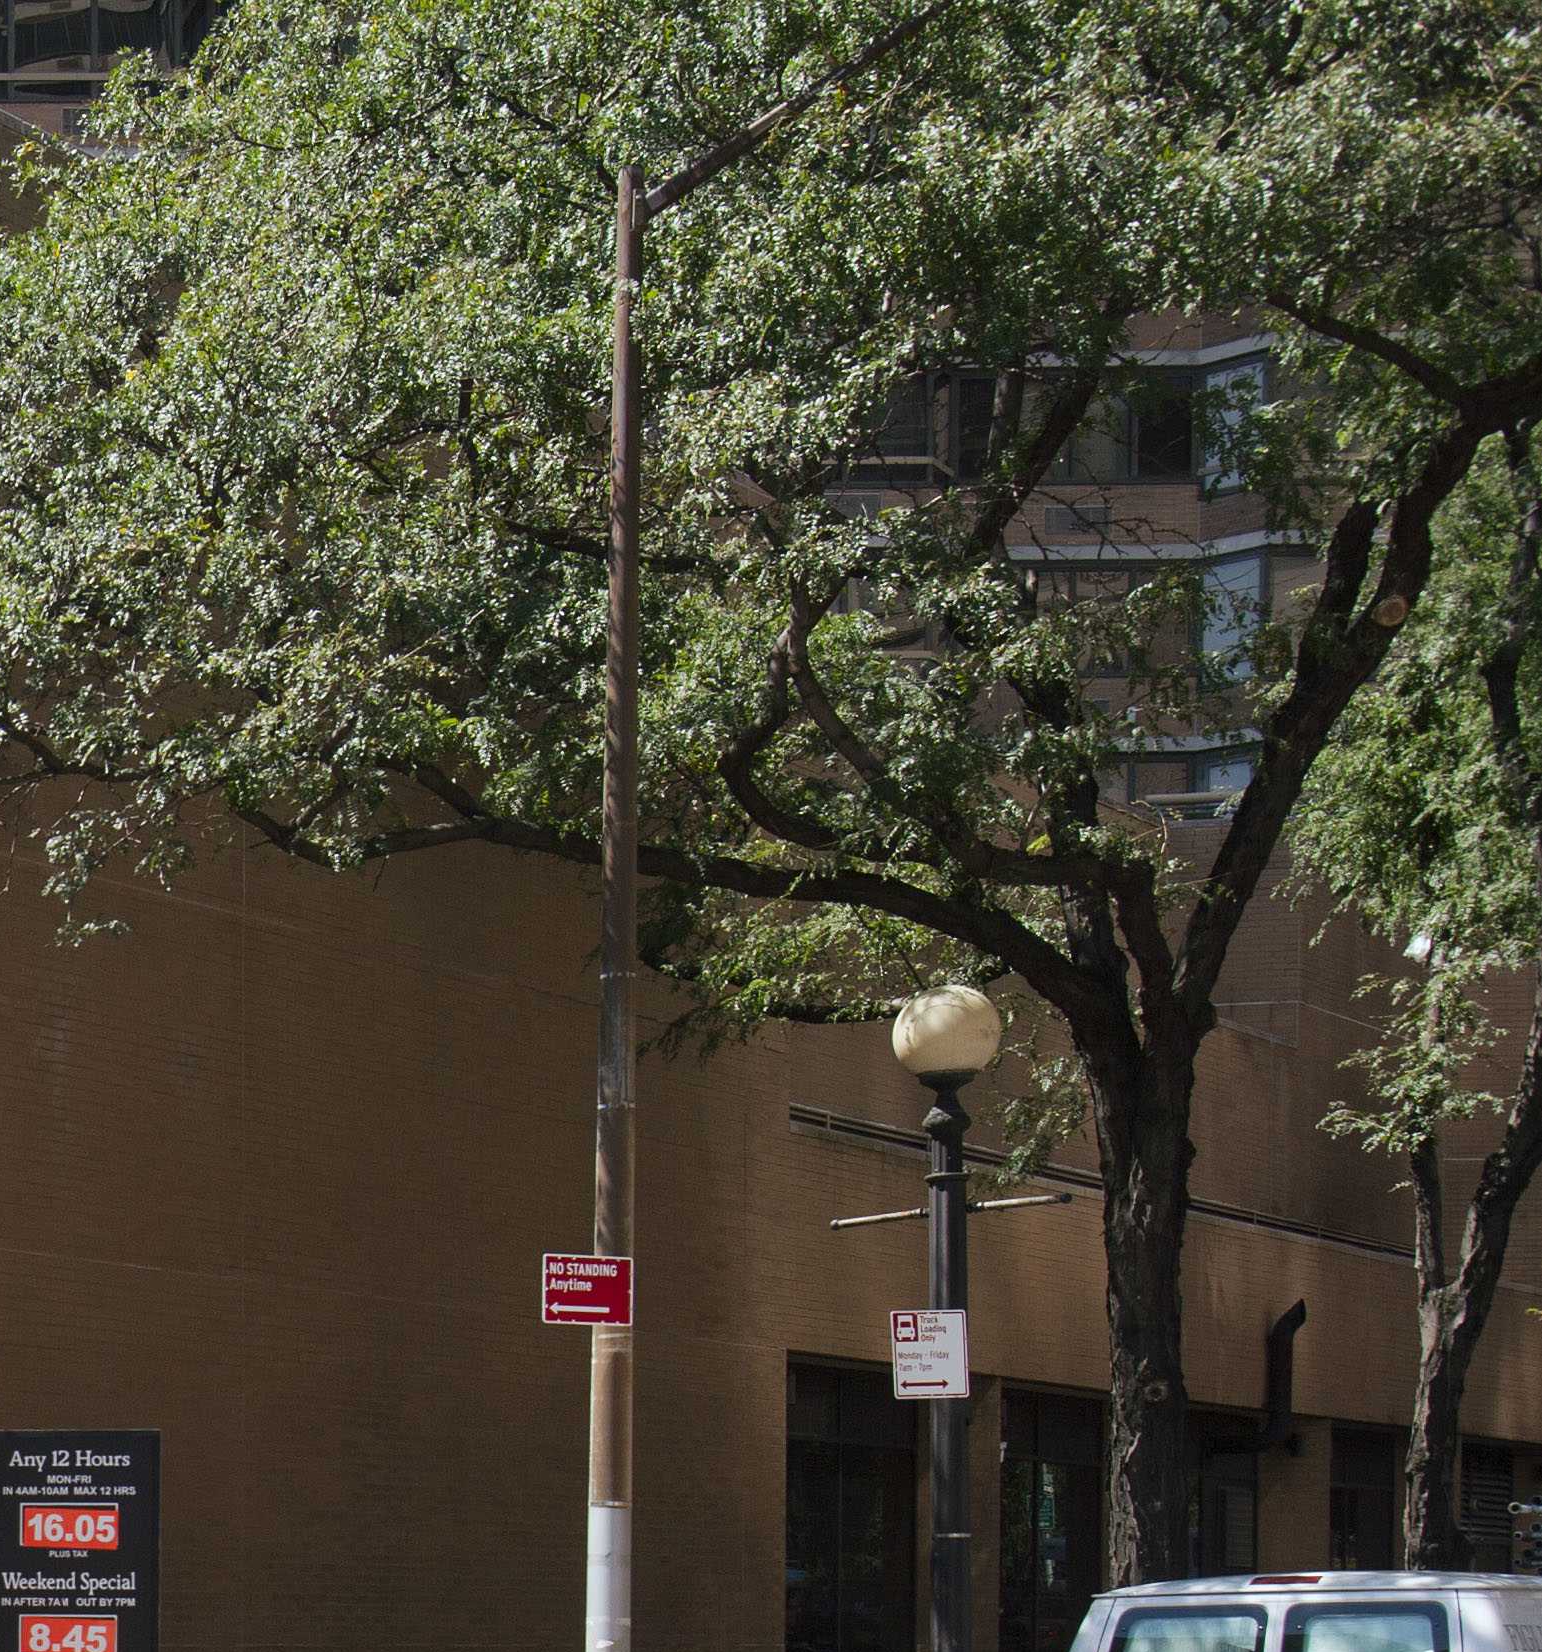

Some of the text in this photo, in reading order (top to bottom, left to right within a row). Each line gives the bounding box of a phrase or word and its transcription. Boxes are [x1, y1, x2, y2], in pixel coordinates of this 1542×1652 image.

[549, 1262, 618, 1277] NO STANDING
[549, 1277, 593, 1293] Anytime
[919, 1315, 938, 1324] Truck
[920, 1325, 947, 1334] Loading
[920, 1334, 936, 1343] Only
[898, 1351, 923, 1361] Monday
[930, 1350, 950, 1360] Friday
[9, 1450, 131, 1472] Any 12 Hours
[47, 1475, 92, 1484] MON-FRI
[2, 1486, 136, 1496] IN 4AM-10AM MAX 12 HRS
[27, 1513, 117, 1543] 16.05
[48, 1550, 89, 1558] PLUS TAX
[1, 1571, 136, 1596] Weekend Special
[1, 1597, 136, 1607] IN AFTER 7AM OUT BY 7PM
